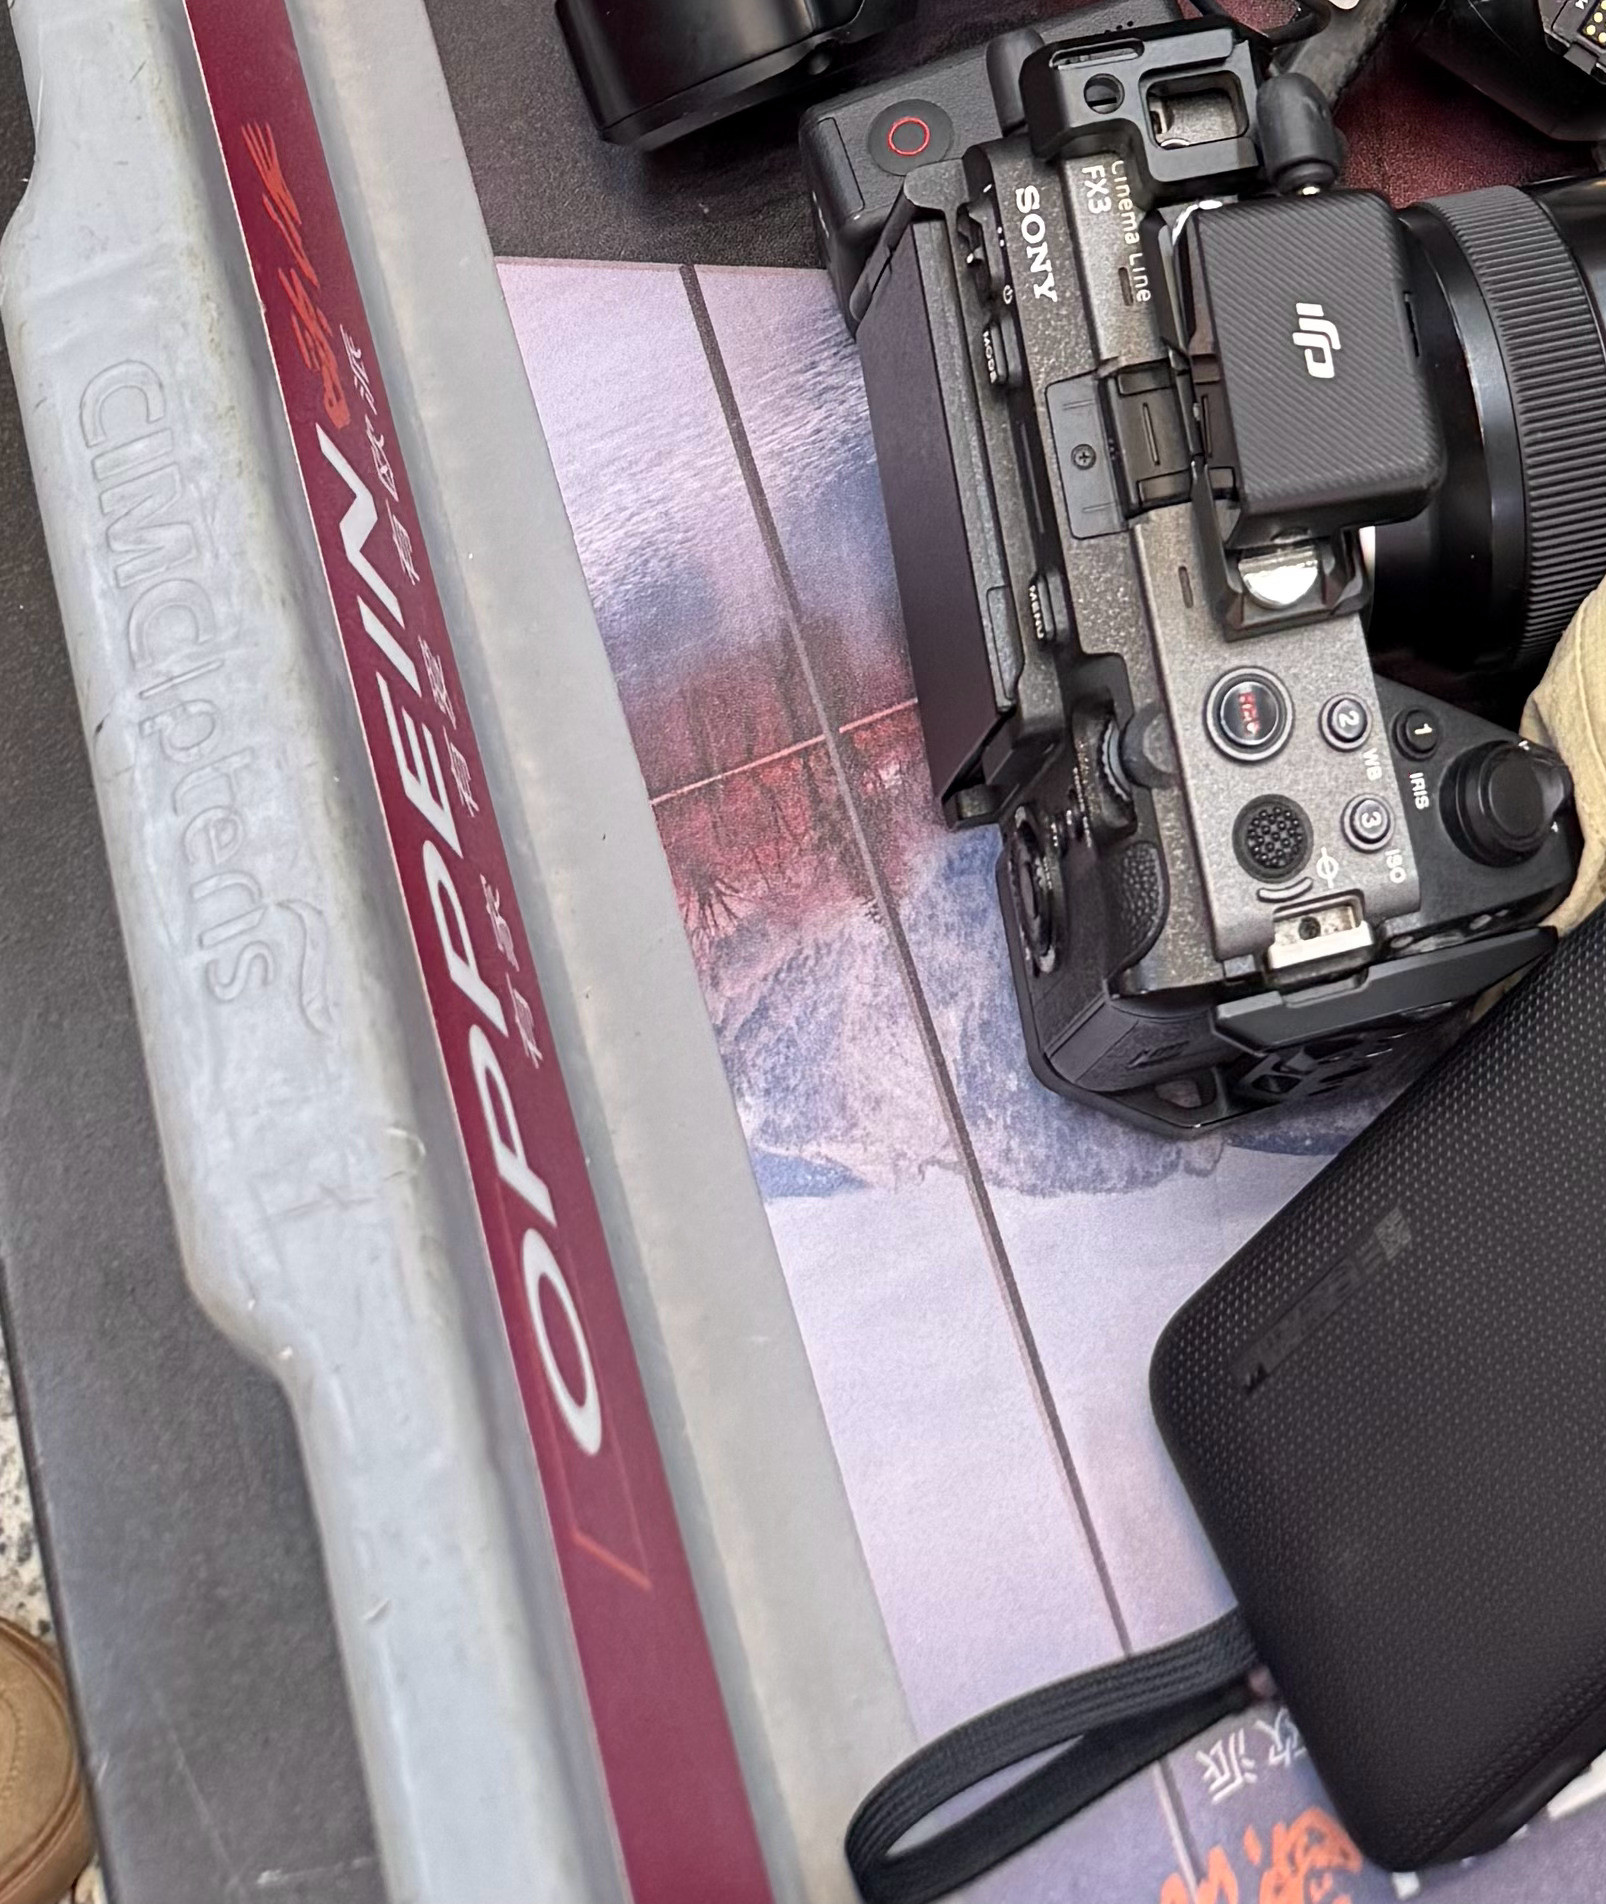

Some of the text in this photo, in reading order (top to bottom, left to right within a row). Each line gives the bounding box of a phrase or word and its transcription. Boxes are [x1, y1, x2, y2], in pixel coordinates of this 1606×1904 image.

[1081, 164, 1112, 214] FX3
[1014, 183, 1059, 304] SONY
[1127, 251, 1153, 304] Line
[1028, 584, 1045, 640] MENU
[1338, 708, 1361, 730] 2
[1411, 722, 1434, 737] 1
[1361, 748, 1384, 782] WB
[1408, 771, 1431, 812] IRIS
[1360, 809, 1382, 831] 3
[1384, 849, 1406, 886] ISO
[315, 422, 603, 1456] OPPEIN
